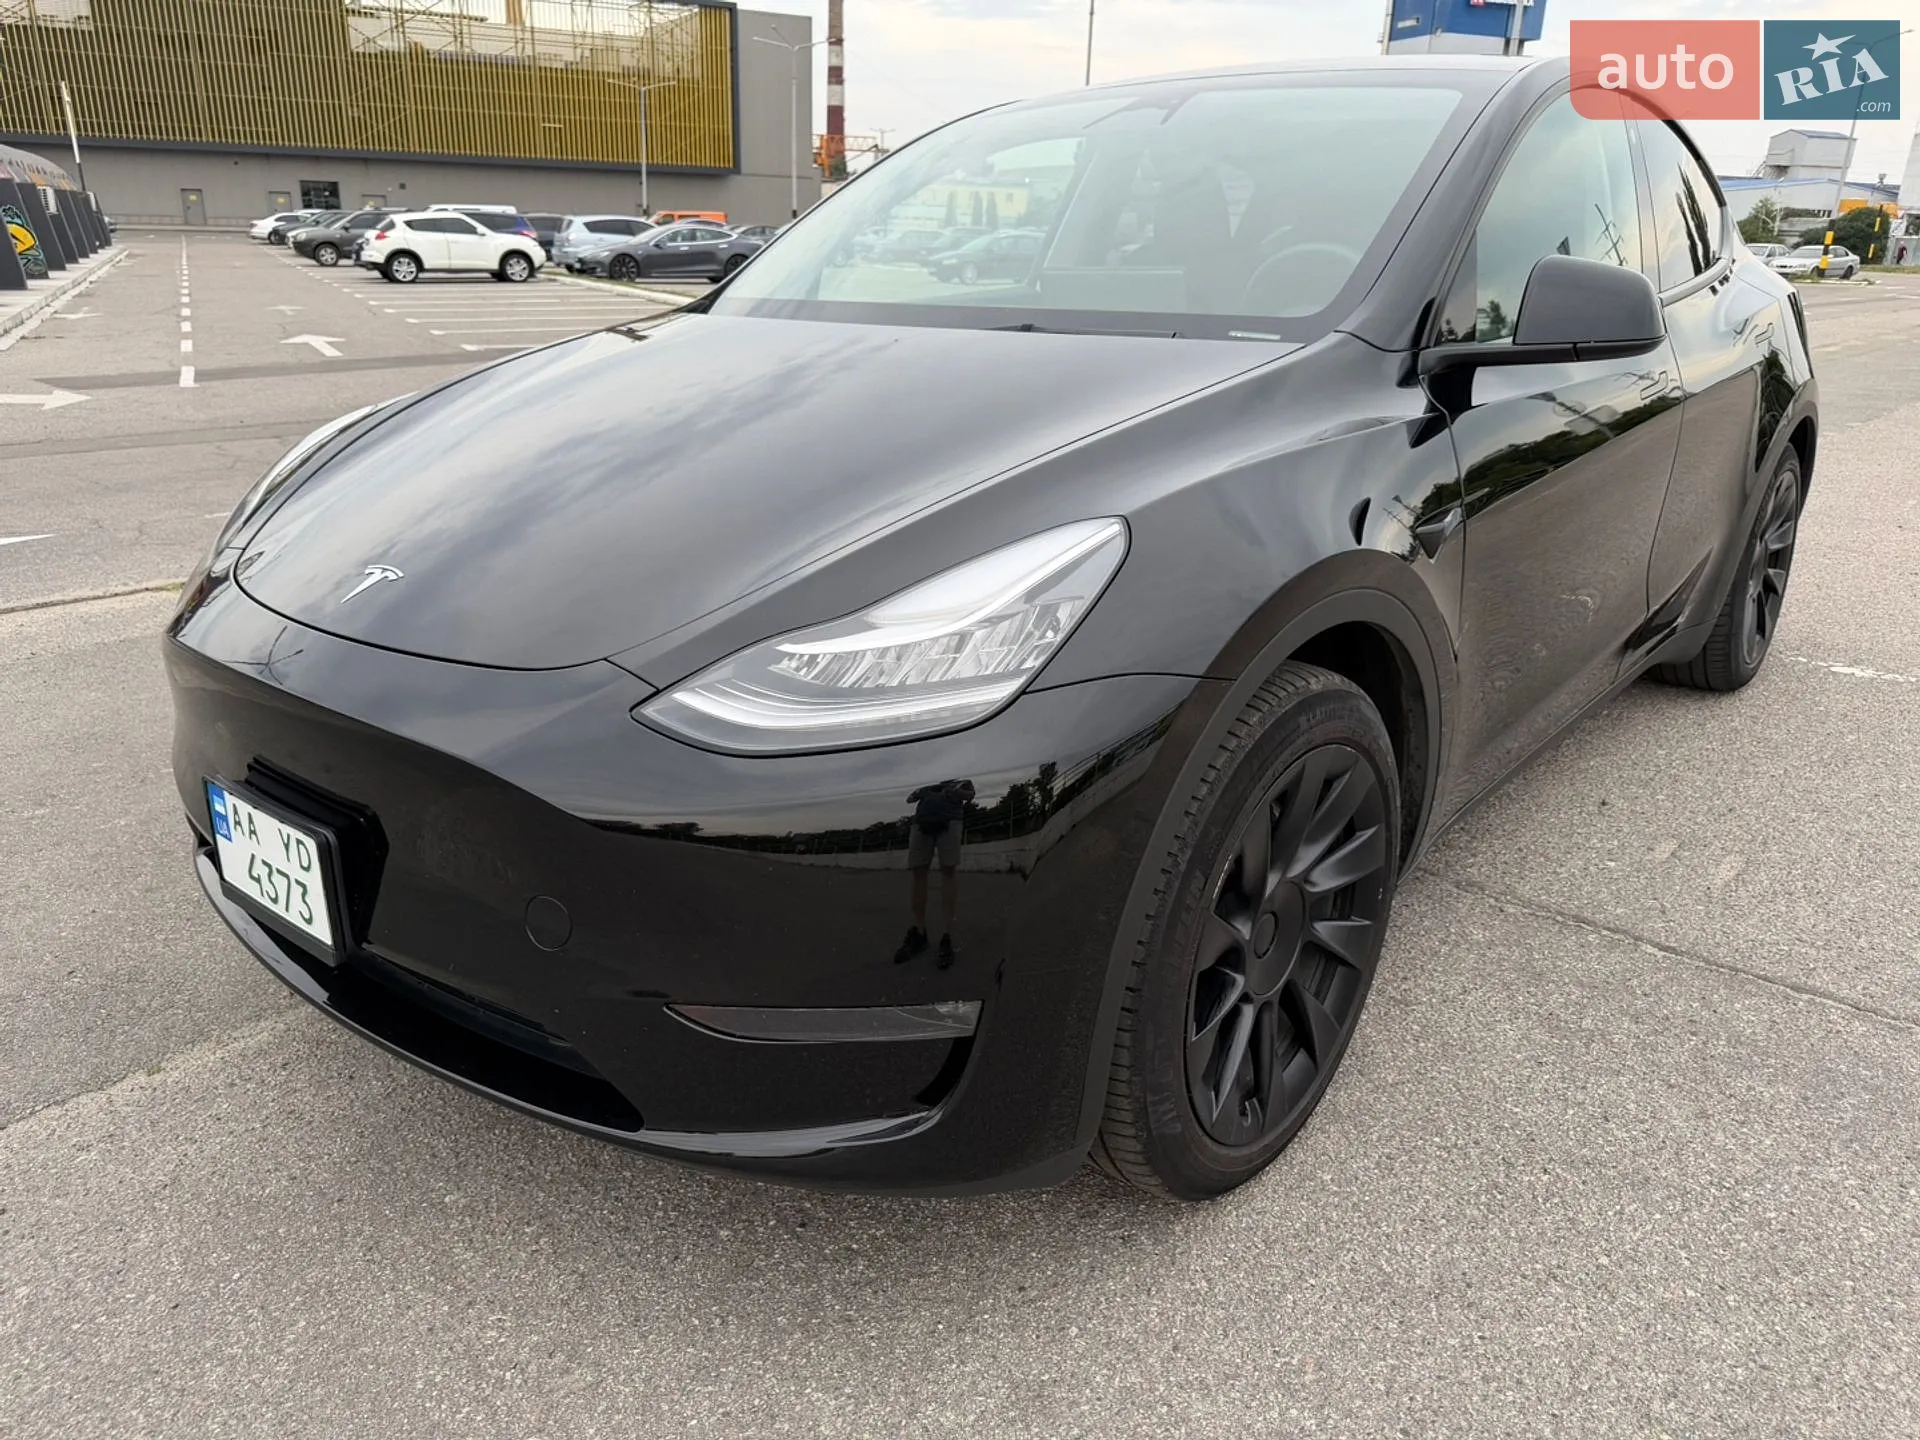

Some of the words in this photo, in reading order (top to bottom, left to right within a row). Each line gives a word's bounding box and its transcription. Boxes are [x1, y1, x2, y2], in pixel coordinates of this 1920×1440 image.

[232, 803, 260, 845] AA
[278, 828, 311, 872] YD
[248, 853, 312, 925] 4373
